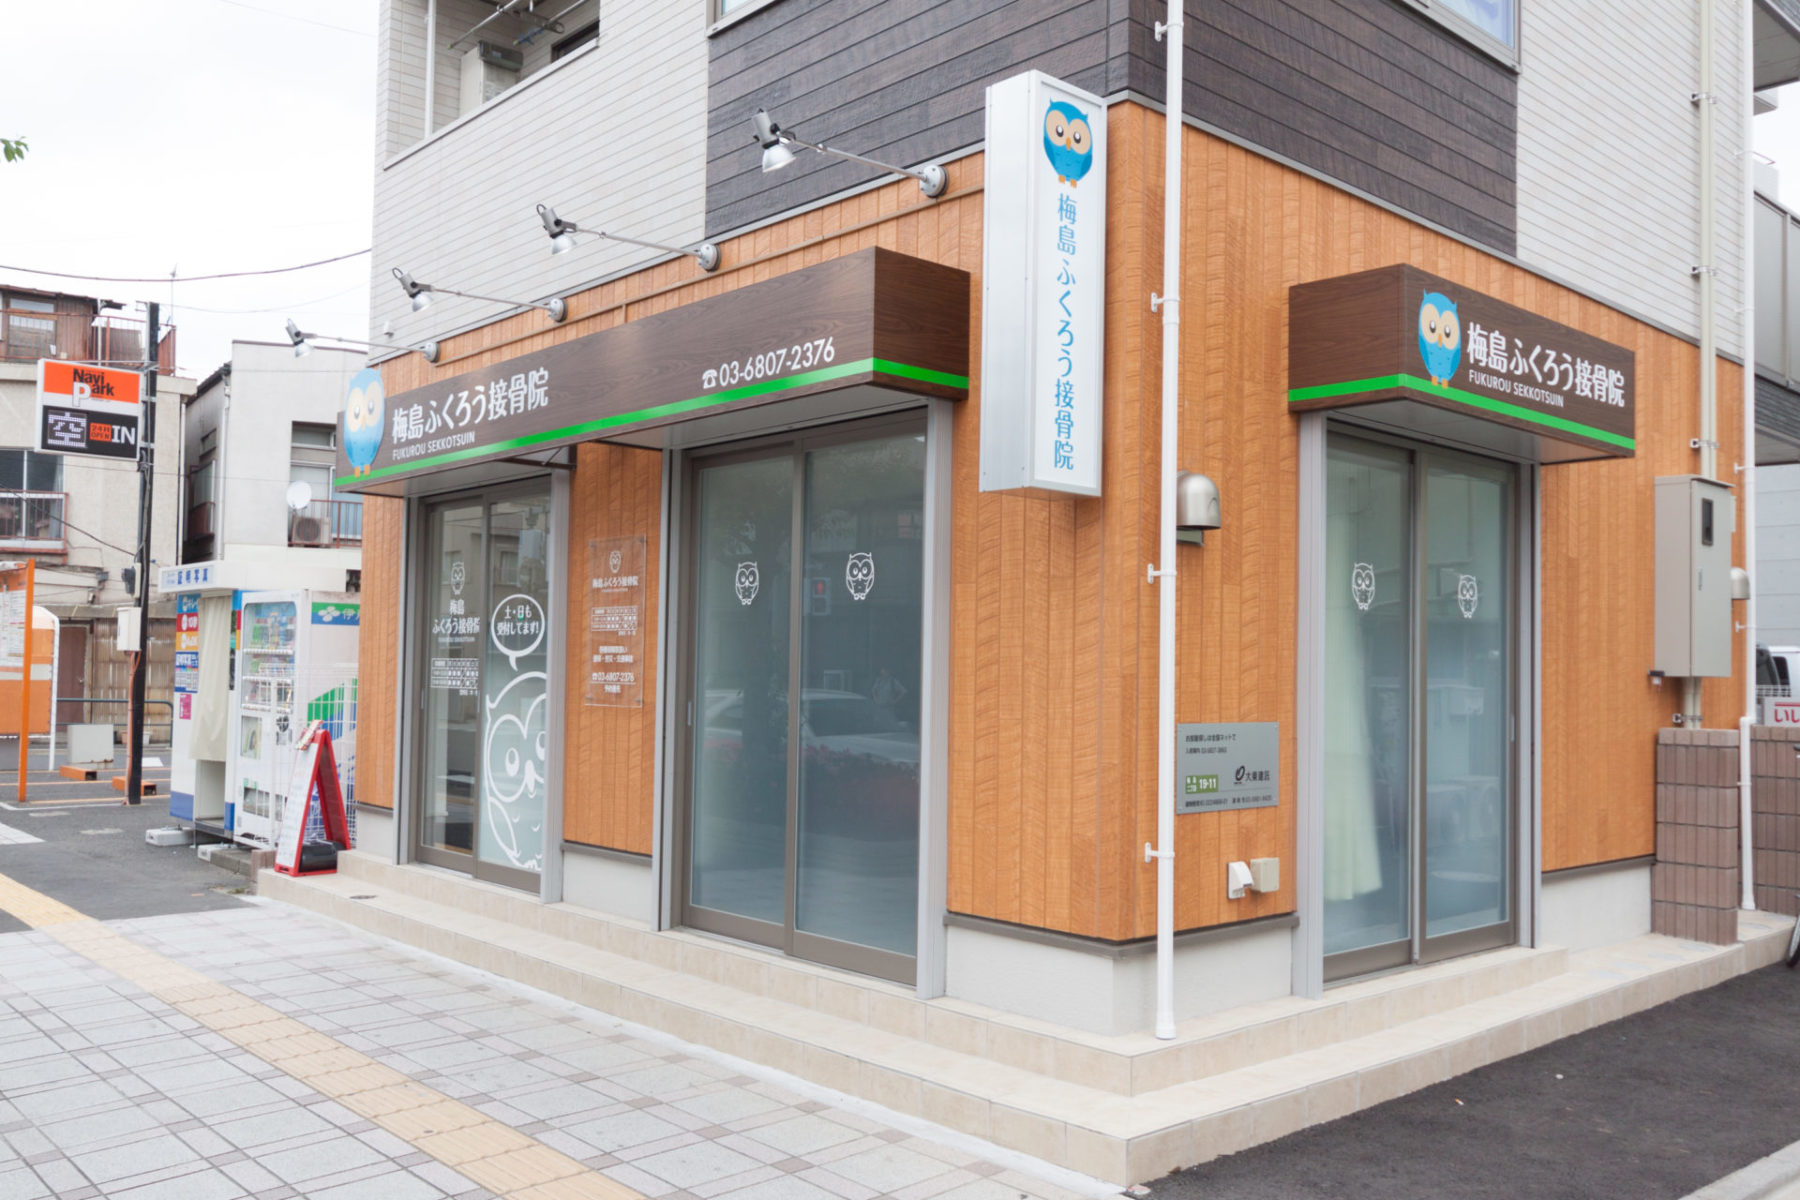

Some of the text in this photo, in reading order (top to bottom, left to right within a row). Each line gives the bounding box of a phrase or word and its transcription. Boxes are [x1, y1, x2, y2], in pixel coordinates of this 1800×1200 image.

[1054, 193, 1078, 471] 梅島ふくろう接骨院
[73, 368, 105, 385] Navi
[719, 336, 835, 387] 03-6807-2376
[1467, 321, 1625, 408] 梅島ふくろう接骨院
[72, 381, 115, 407] Park
[391, 366, 549, 445] 梅島ふくろう接骨院
[1469, 369, 1564, 408] FUKUROU SEKKOTSUIN
[47, 411, 87, 448] 空
[112, 425, 136, 445] IN
[392, 431, 475, 461] FUKUROU SEKKOTSUIN
